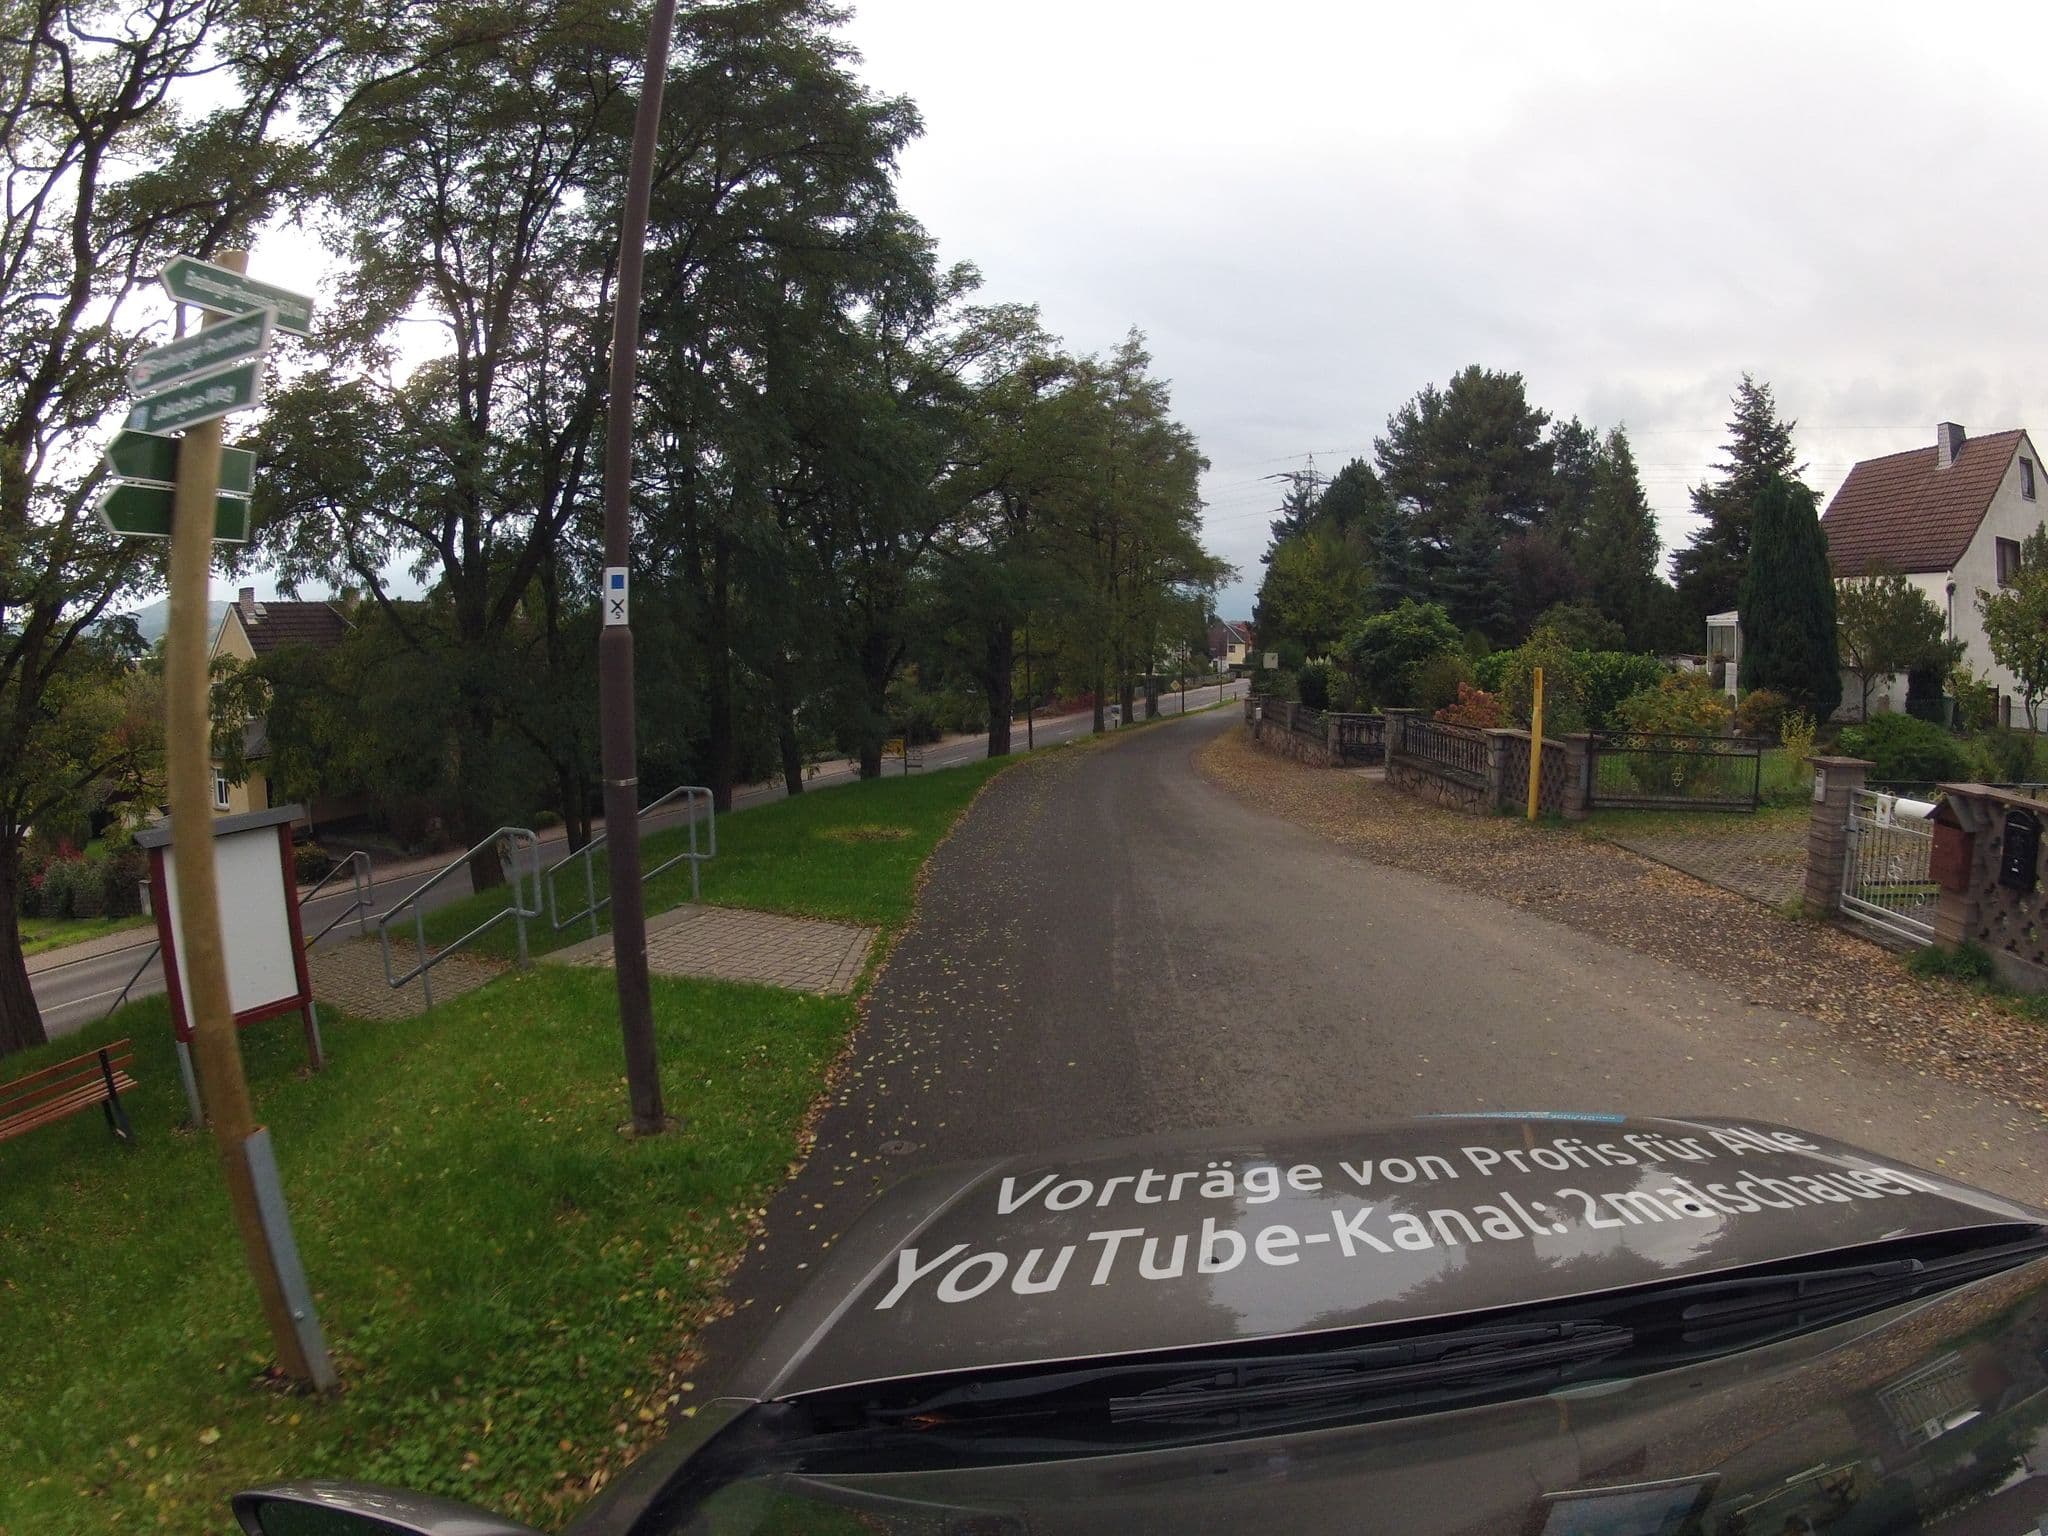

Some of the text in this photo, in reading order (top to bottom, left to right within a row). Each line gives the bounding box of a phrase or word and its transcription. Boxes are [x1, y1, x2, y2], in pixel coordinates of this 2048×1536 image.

[997, 1127, 1821, 1215] Vorträge von Profis für Alle
[874, 1163, 1941, 1311] YouTube-Kanal: 2malschauen
